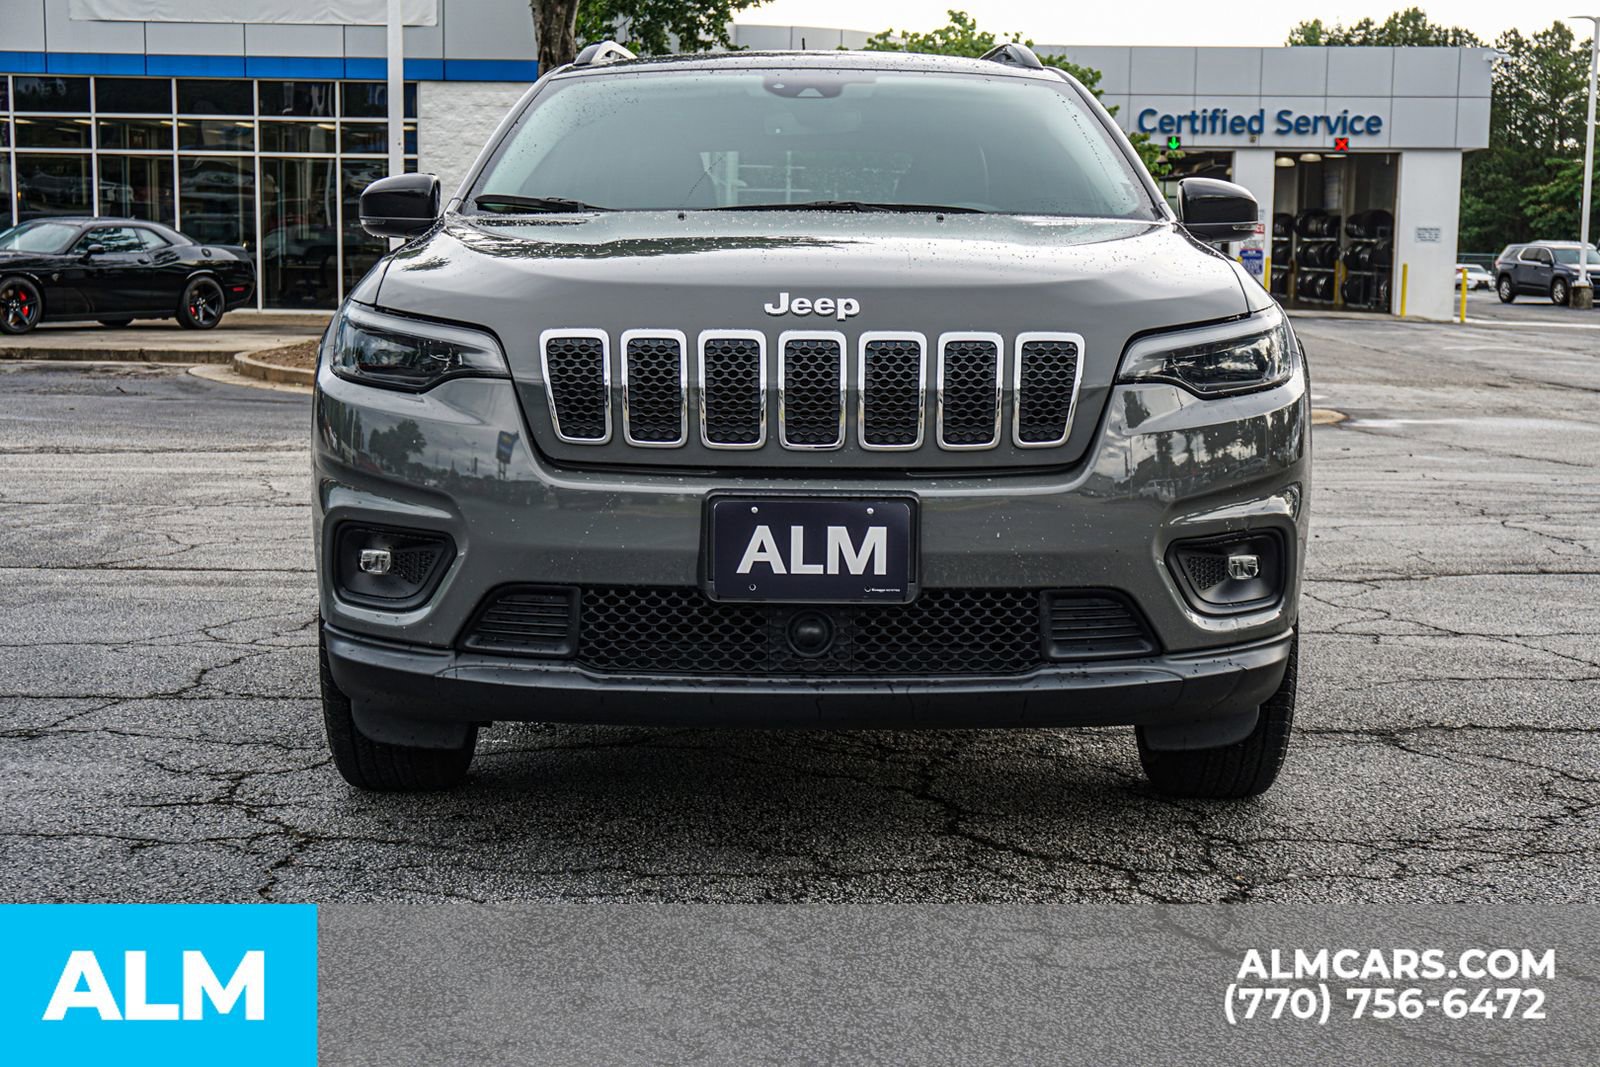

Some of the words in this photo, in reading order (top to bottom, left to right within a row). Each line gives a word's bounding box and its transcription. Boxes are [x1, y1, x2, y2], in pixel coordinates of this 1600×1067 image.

[1138, 108, 1265, 135] Certified
[1275, 109, 1383, 135] Service
[764, 292, 860, 320] Jeep
[736, 525, 888, 576] ALM
